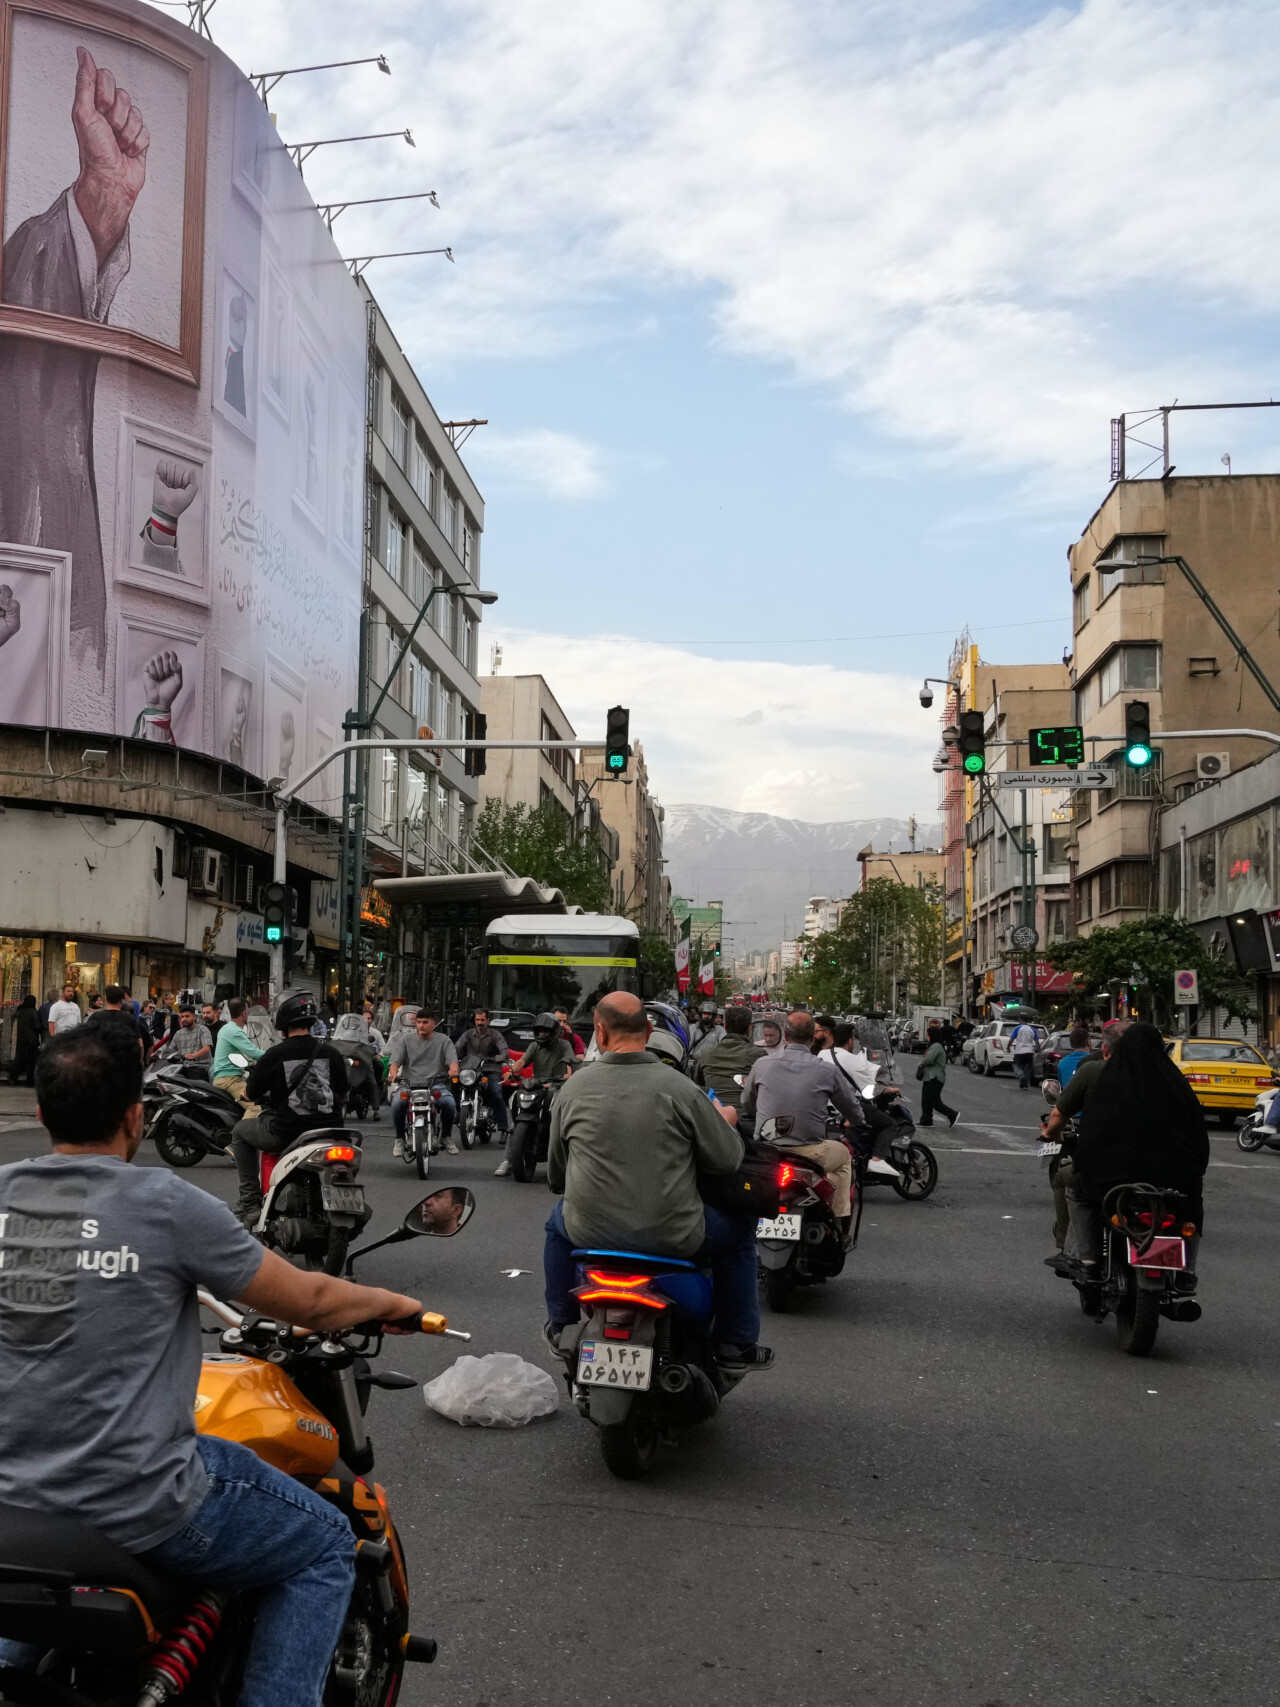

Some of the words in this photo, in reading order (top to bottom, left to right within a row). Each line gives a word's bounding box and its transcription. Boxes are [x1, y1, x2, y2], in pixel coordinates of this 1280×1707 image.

[1004, 775, 1036, 785] اسلامی
[1038, 775, 1073, 785] جمهوری
[606, 1346, 641, 1366] ۱۴۴
[582, 1364, 646, 1386] ۵۶۵۷۳
